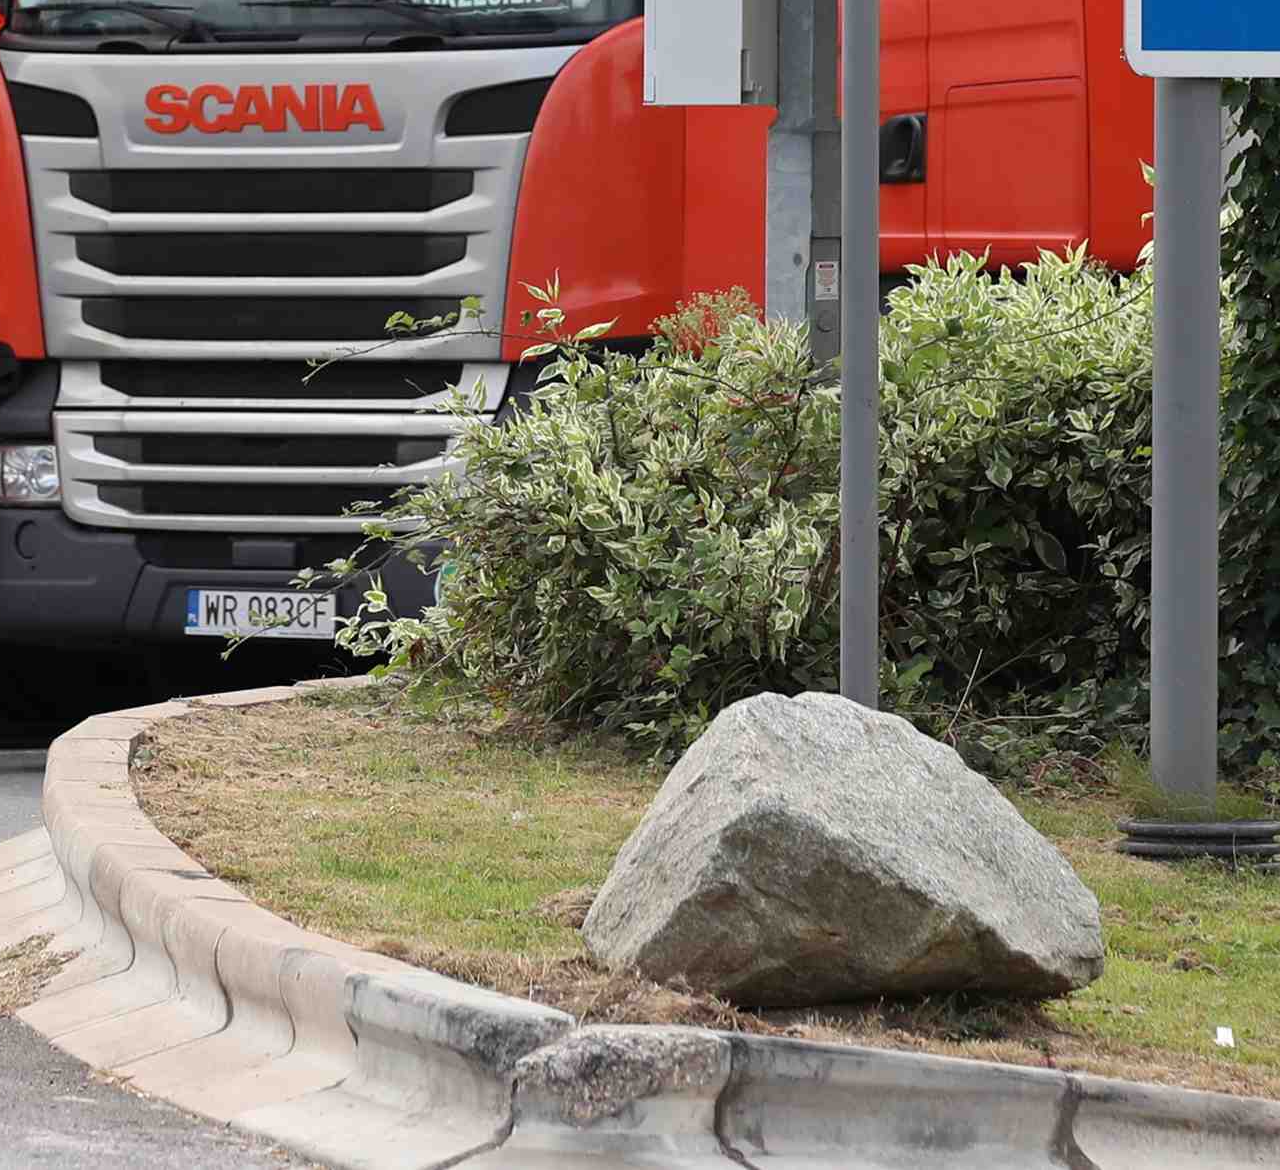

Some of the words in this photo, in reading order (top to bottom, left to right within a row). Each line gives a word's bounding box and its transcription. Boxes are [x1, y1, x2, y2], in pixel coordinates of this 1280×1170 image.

[144, 84, 384, 135] SCANIA
[205, 594, 237, 626] WR
[248, 596, 329, 628] 083CF
